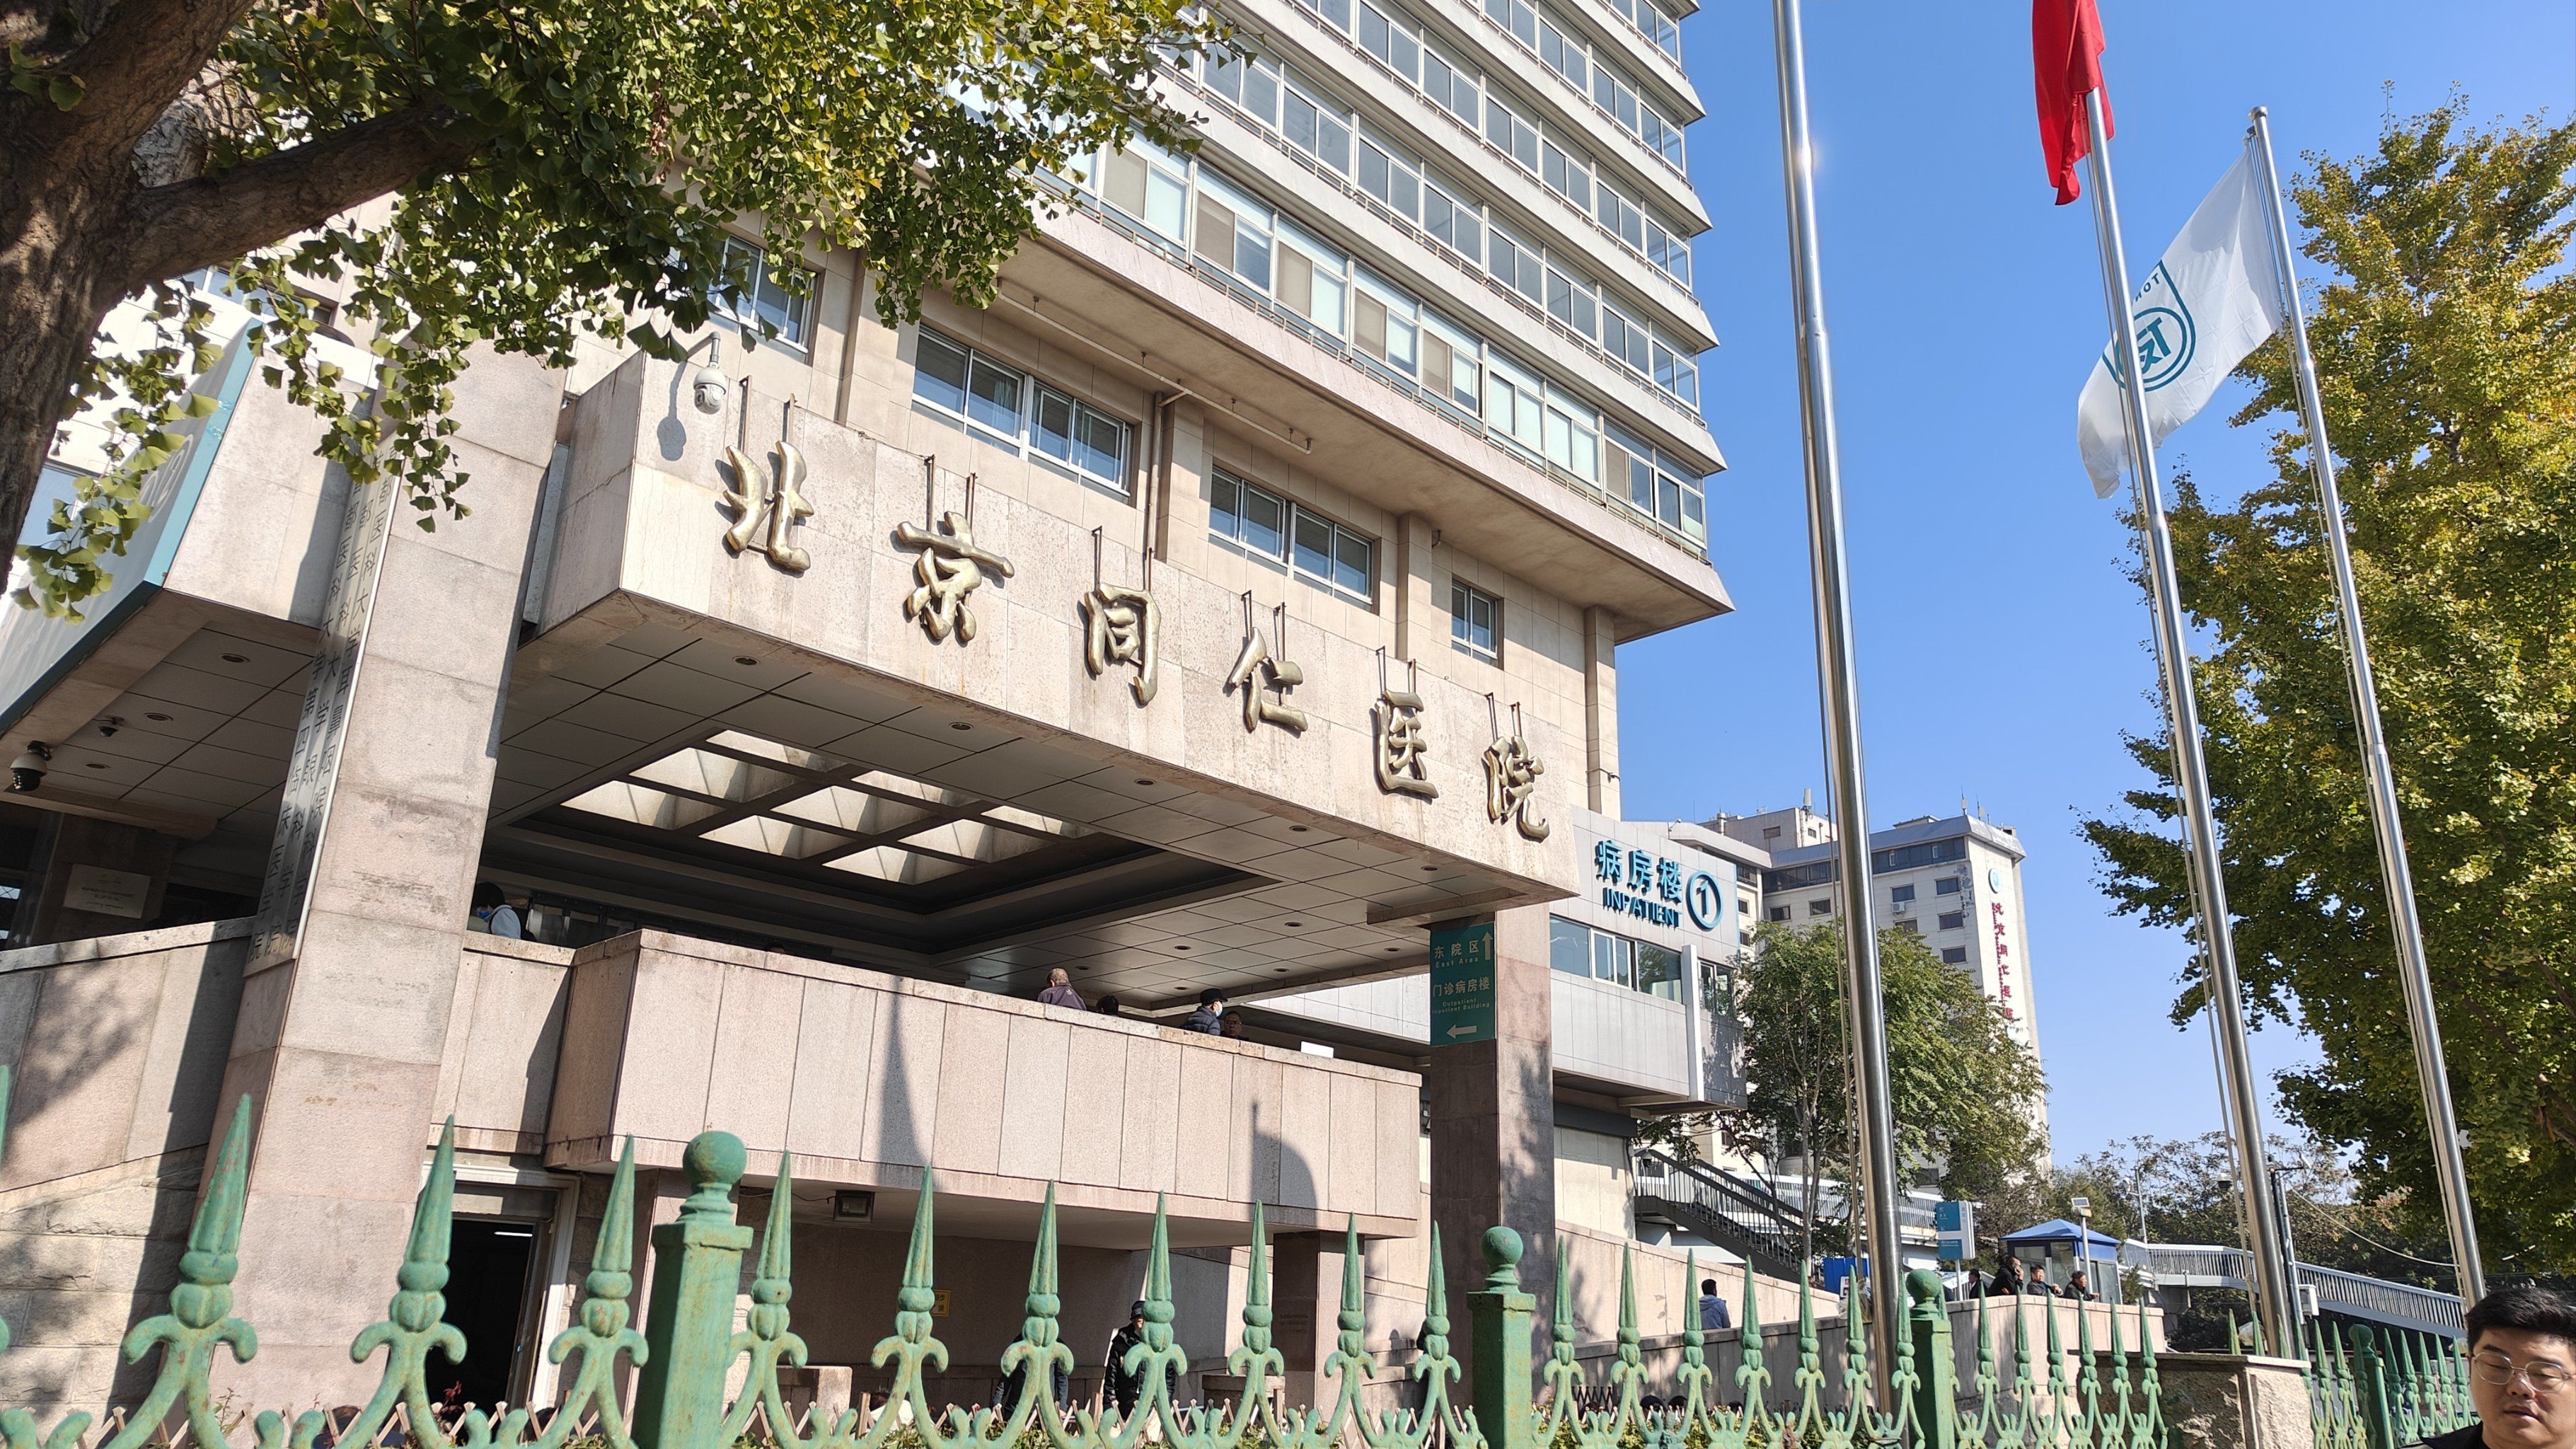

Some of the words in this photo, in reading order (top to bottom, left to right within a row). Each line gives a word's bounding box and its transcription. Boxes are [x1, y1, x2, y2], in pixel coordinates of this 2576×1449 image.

[722, 439, 1550, 843] 北京同仁医院
[1595, 840, 1683, 906] 病房楼
[1602, 887, 1682, 930] INPATIENT
[1433, 940, 1479, 959] 东院区
[1436, 960, 1455, 969] East
[1433, 976, 1490, 997] 门诊病房楼
[1443, 998, 1477, 1007] Outpatient
[1463, 1002, 1490, 1011] Building
